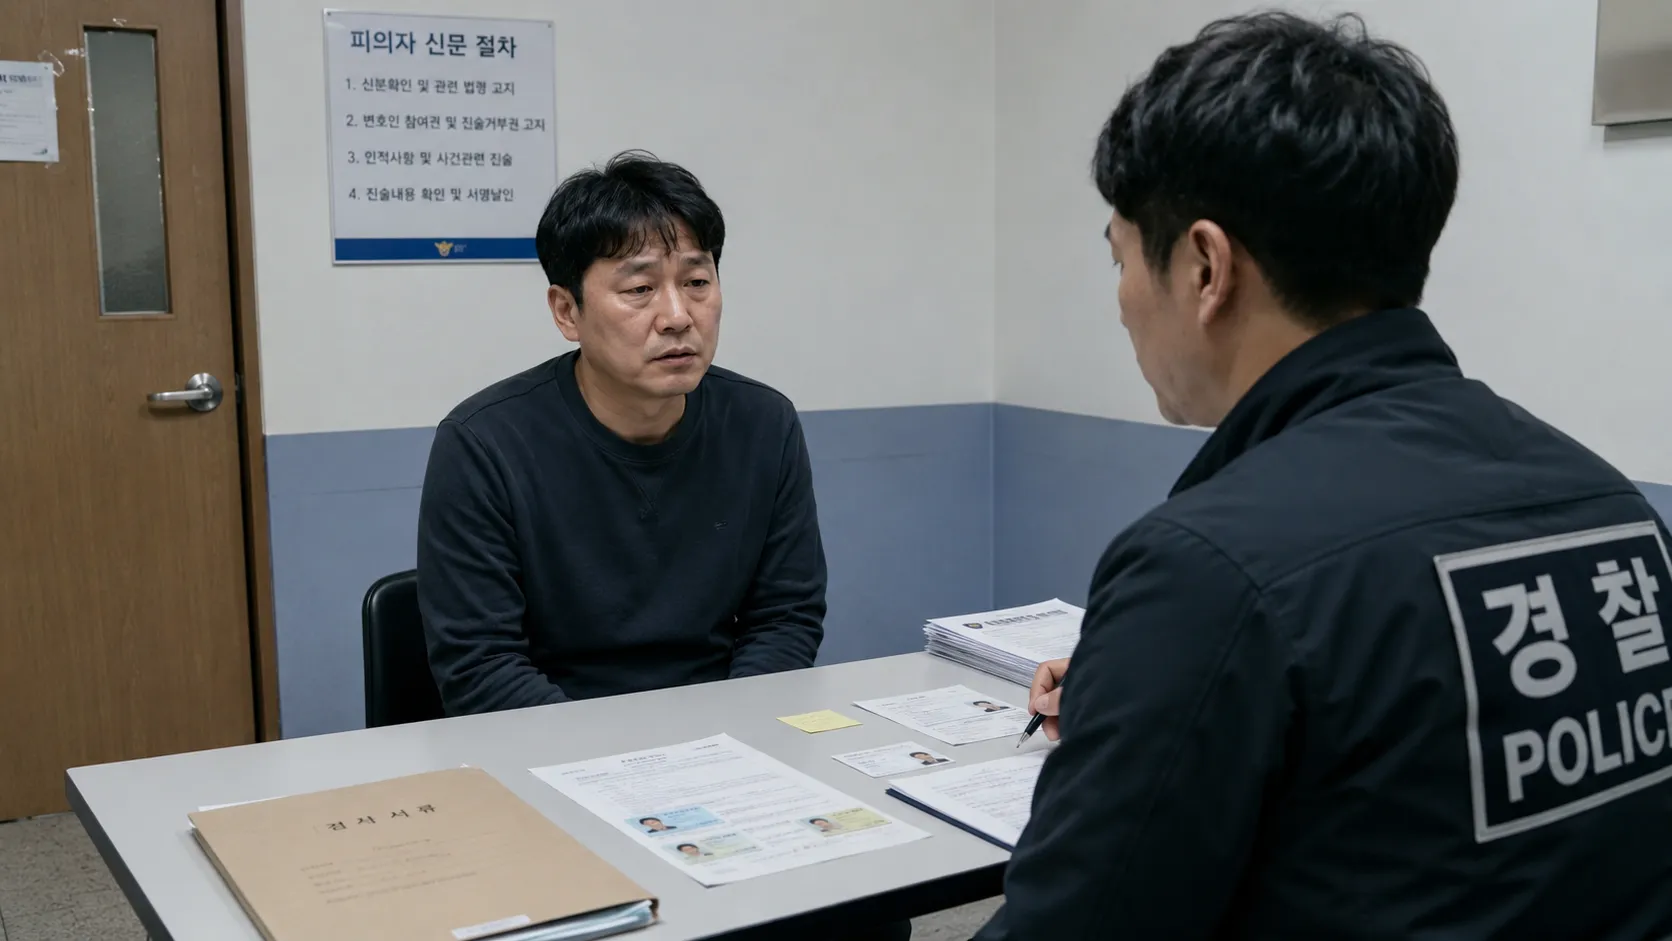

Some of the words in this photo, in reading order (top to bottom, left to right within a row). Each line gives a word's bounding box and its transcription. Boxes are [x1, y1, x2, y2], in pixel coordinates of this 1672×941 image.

[350, 29, 416, 55] 피의자
[425, 32, 468, 57] 신문
[475, 35, 518, 59] 절차
[346, 77, 357, 91] 1.
[362, 77, 412, 92] 신분확인
[418, 79, 429, 93] 및
[434, 79, 459, 94] 관련
[464, 80, 487, 95] 법령
[491, 81, 516, 96] 고지
[346, 114, 358, 128] 2.
[363, 114, 400, 129] 변호인
[405, 115, 441, 130] 참여권
[445, 116, 457, 130] 및
[462, 116, 519, 131] 진술거부권
[523, 118, 546, 132] 고지
[347, 150, 360, 165] 3.
[364, 150, 415, 165] 인적사항
[420, 151, 431, 166] 및
[436, 152, 485, 166] 사건관련
[490, 152, 513, 167] 진술
[348, 187, 361, 201] 4.
[366, 187, 416, 202] 진술내용
[421, 187, 446, 202] 확인
[450, 187, 462, 202] 및
[467, 187, 515, 202] 서명날인
